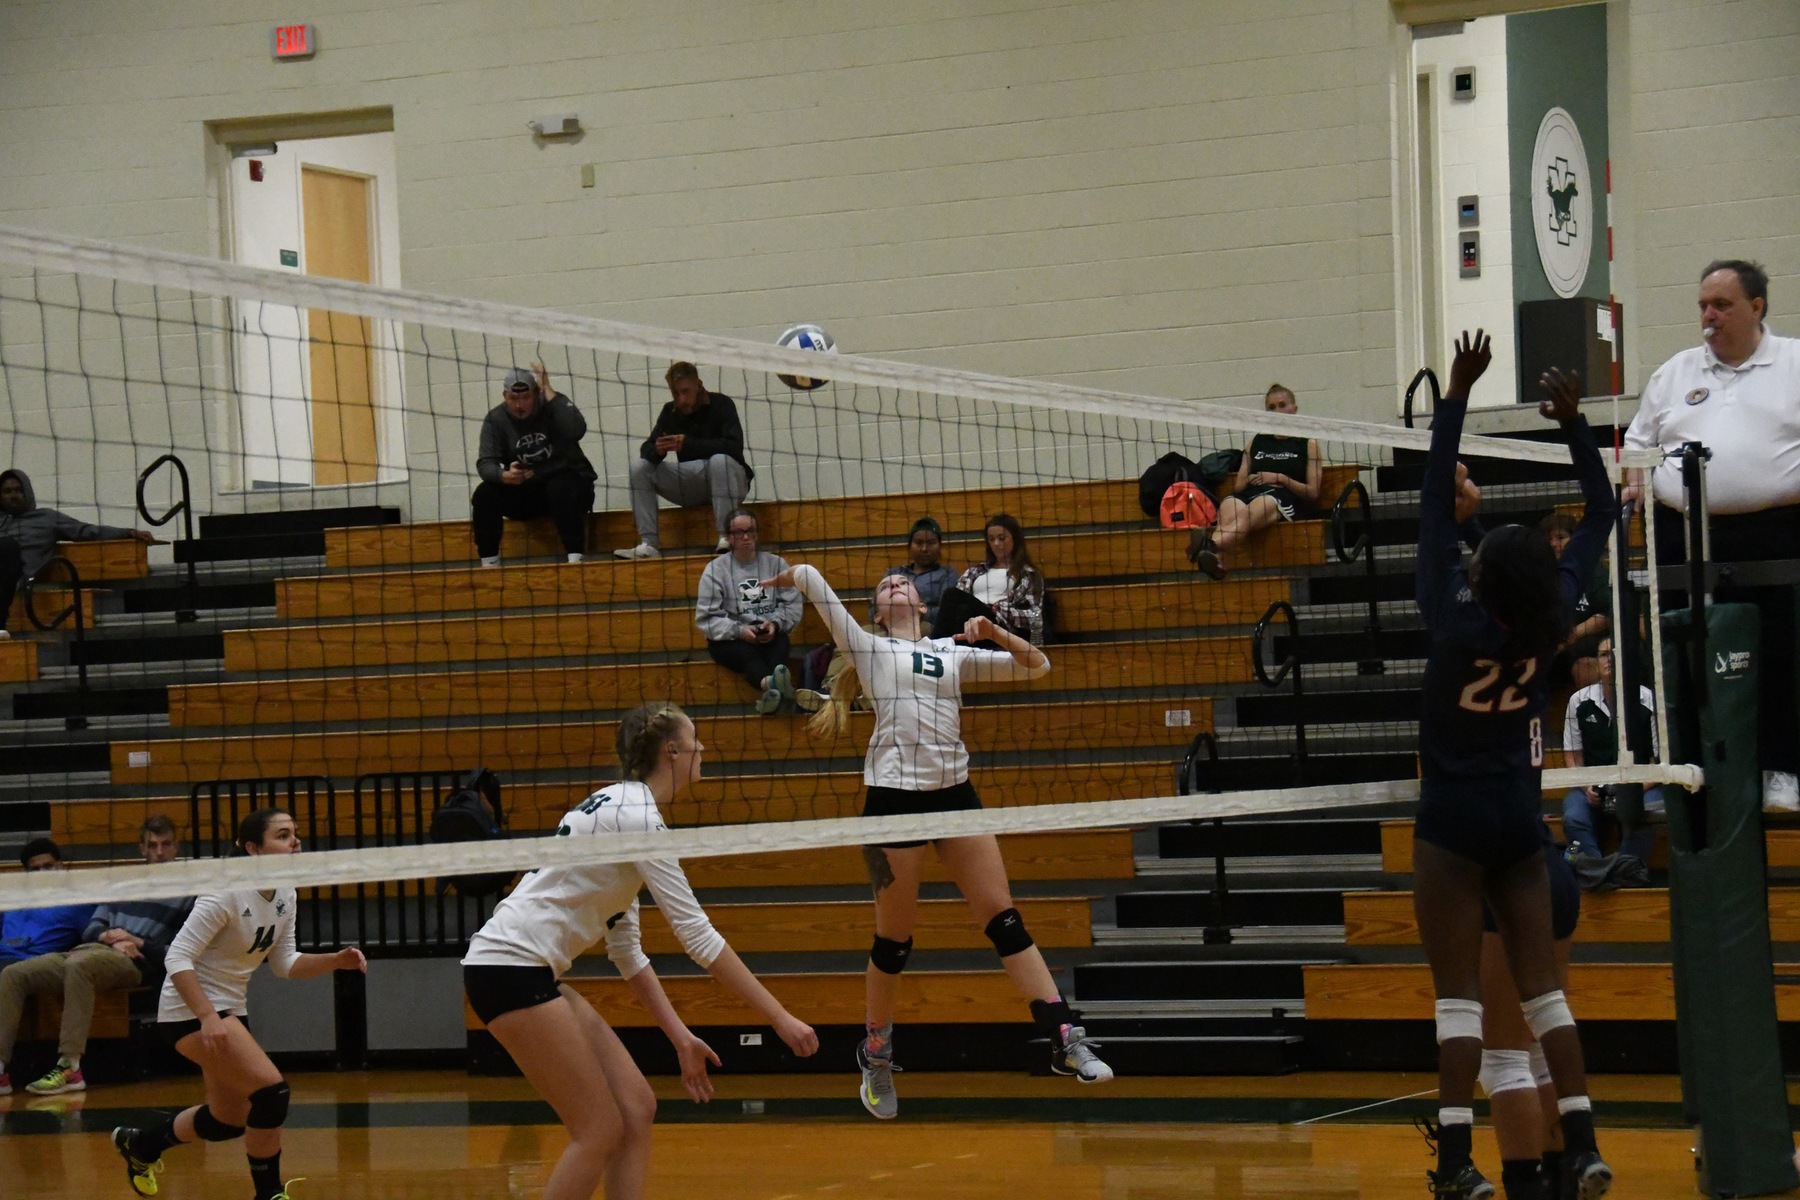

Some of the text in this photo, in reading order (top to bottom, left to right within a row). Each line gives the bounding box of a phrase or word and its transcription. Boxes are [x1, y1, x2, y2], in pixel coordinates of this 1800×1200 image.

[276, 25, 307, 55] EXIT
[911, 652, 944, 678] 13
[1459, 658, 1537, 713] 22
[247, 924, 276, 954] 14
